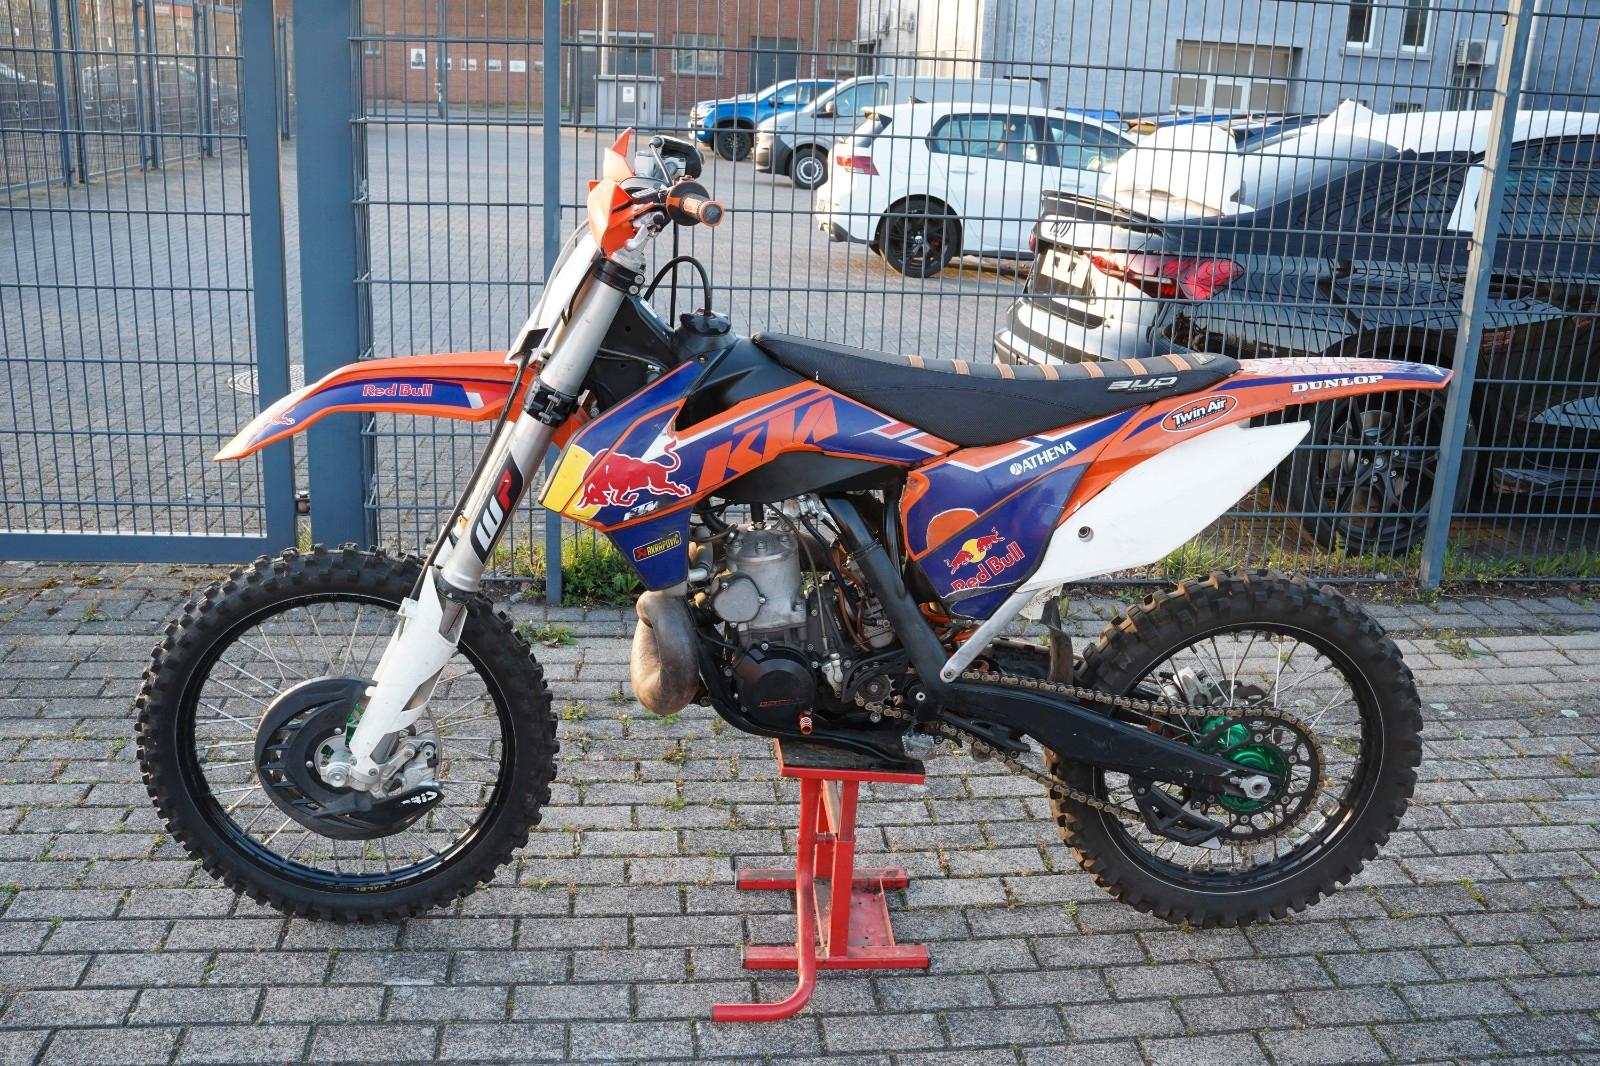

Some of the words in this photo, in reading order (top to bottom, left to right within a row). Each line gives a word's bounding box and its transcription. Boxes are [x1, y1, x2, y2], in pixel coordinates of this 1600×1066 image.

[362, 383, 397, 397] Red
[399, 383, 433, 397] Bull
[1292, 375, 1383, 393] DUNLOP
[1172, 407, 1206, 426] Twin
[1207, 399, 1227, 413] Air
[696, 391, 839, 493] KTM
[1022, 440, 1077, 473] ATHENA
[951, 563, 992, 592] Red
[985, 541, 1026, 576] Bull
